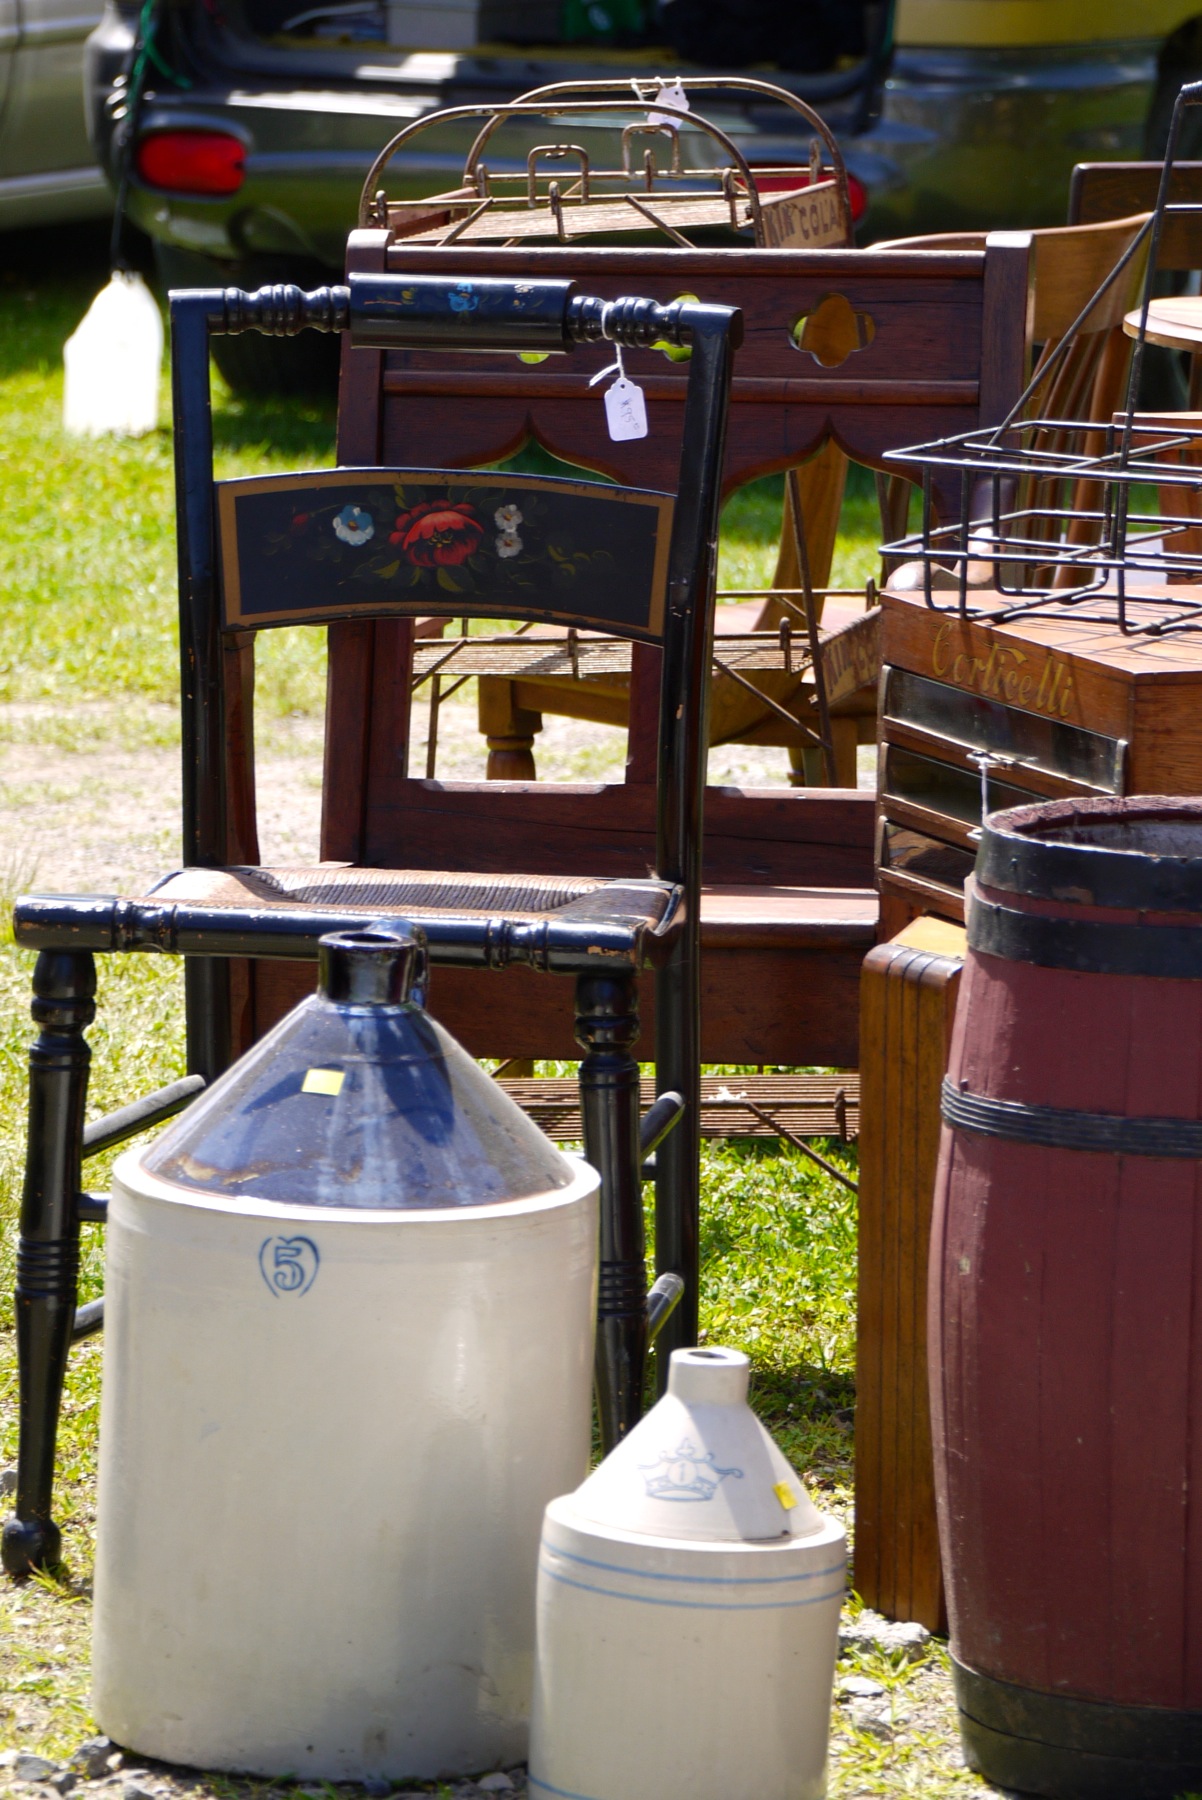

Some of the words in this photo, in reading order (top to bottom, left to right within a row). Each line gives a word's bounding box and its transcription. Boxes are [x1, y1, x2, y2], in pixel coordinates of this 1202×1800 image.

[800, 199, 841, 241] COLA
[928, 620, 1075, 718] Corticelli
[274, 1245, 306, 1292] 5
